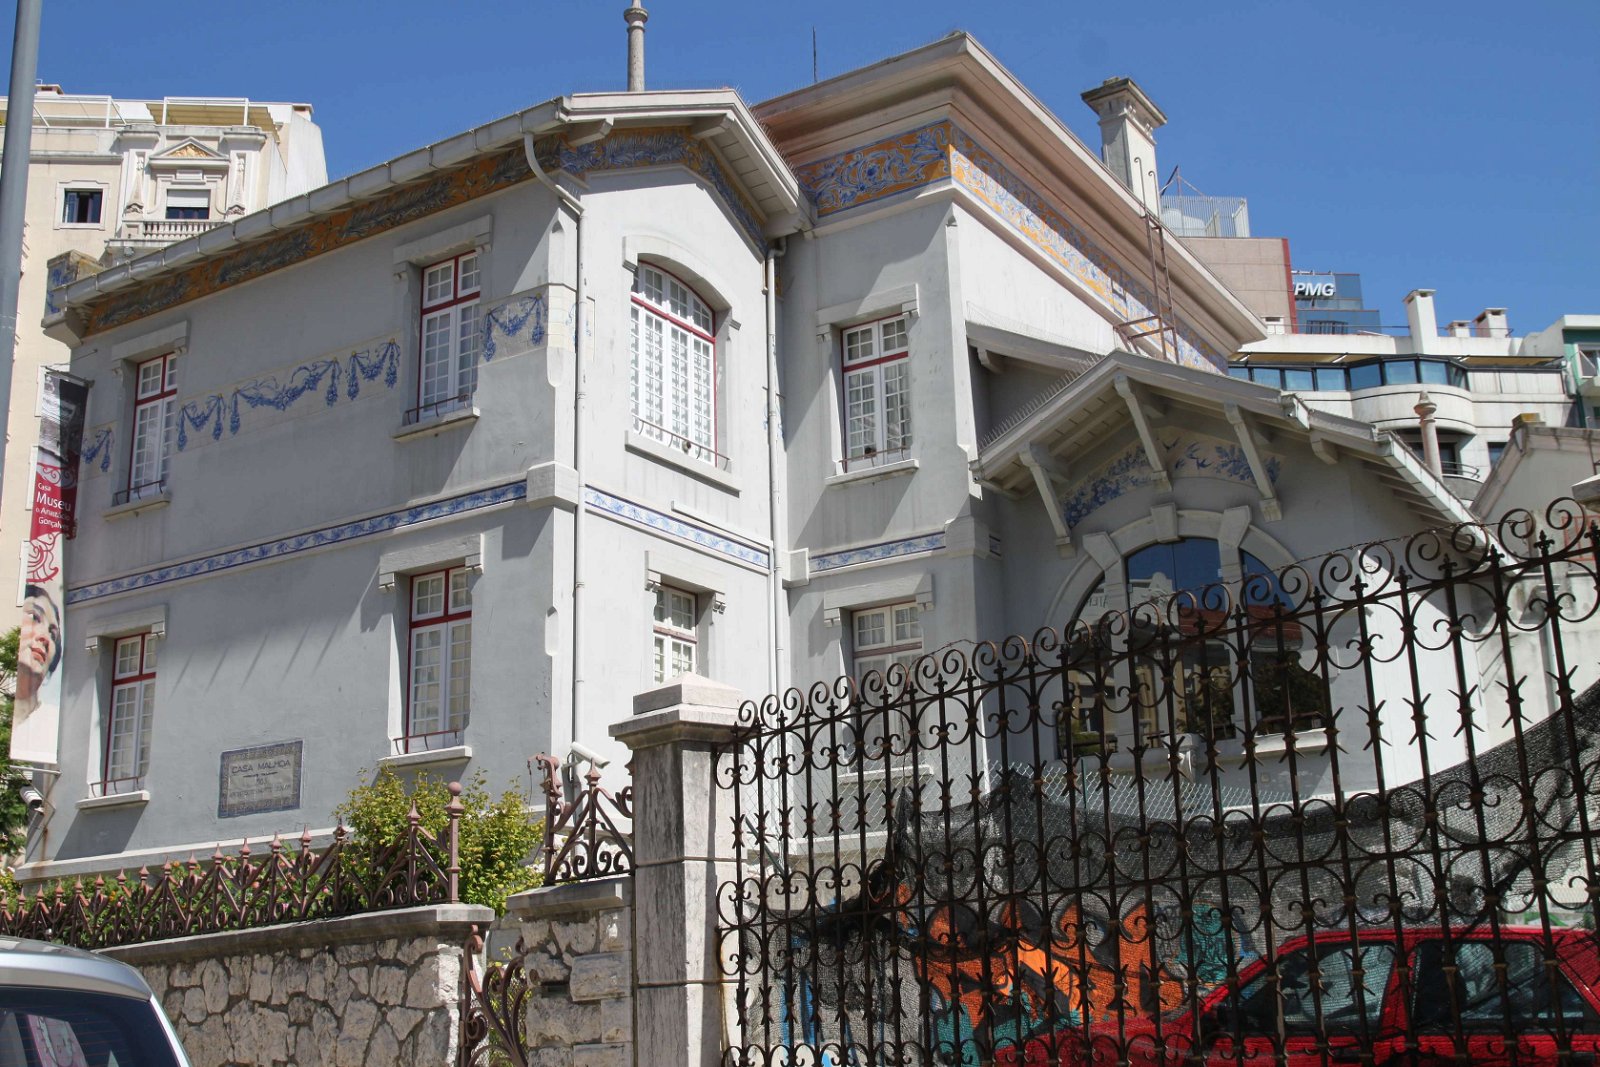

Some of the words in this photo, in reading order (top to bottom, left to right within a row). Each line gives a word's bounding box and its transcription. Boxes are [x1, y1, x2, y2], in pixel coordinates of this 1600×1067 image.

[1292, 282, 1335, 296] PMG
[37, 482, 51, 492] Casa
[36, 491, 71, 511] Museu
[231, 764, 253, 774] CASA
[257, 759, 291, 770] MALHOA
